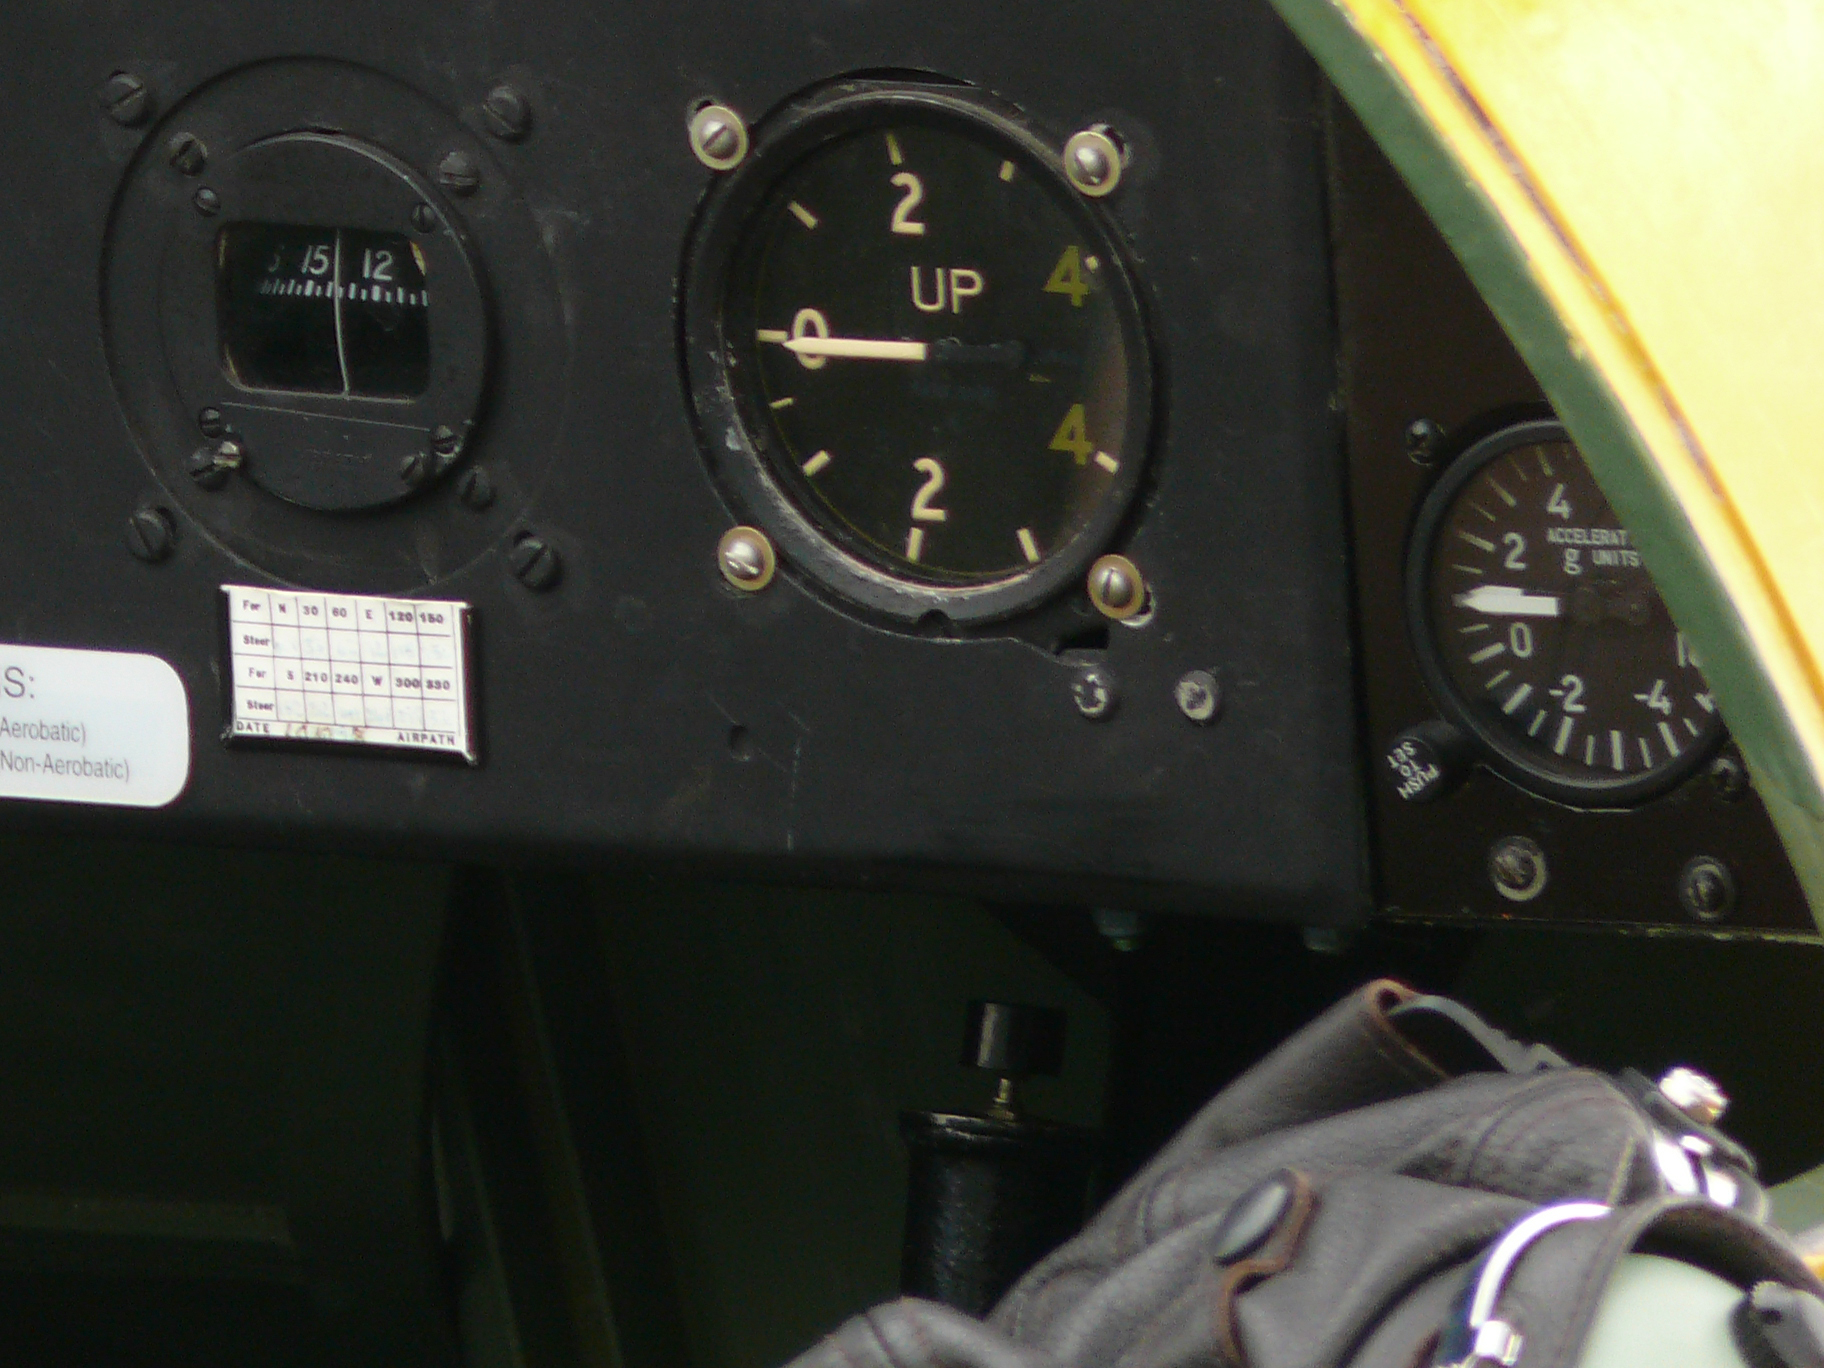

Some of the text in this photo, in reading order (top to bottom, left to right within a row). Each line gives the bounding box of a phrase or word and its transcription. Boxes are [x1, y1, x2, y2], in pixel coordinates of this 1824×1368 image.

[889, 171, 926, 236] 2
[300, 245, 331, 275] 15
[363, 247, 394, 281] 12
[1042, 244, 1090, 308] 4
[909, 265, 985, 314] UP
[1047, 402, 1095, 466] 4
[911, 456, 948, 522] 2
[1546, 482, 1571, 520] 4
[1502, 531, 1527, 570] 2
[1547, 527, 1627, 546] ACCELERAT
[1591, 548, 1640, 567] UNITS
[302, 605, 319, 616] 30
[389, 611, 414, 623] 120
[1509, 621, 1534, 658] 0
[304, 671, 328, 683] 210
[334, 673, 359, 685] 240
[1548, 673, 1586, 713] -2
[1633, 678, 1673, 715] -4
[236, 720, 271, 734] DATE
[397, 732, 456, 747] AIRPATH
